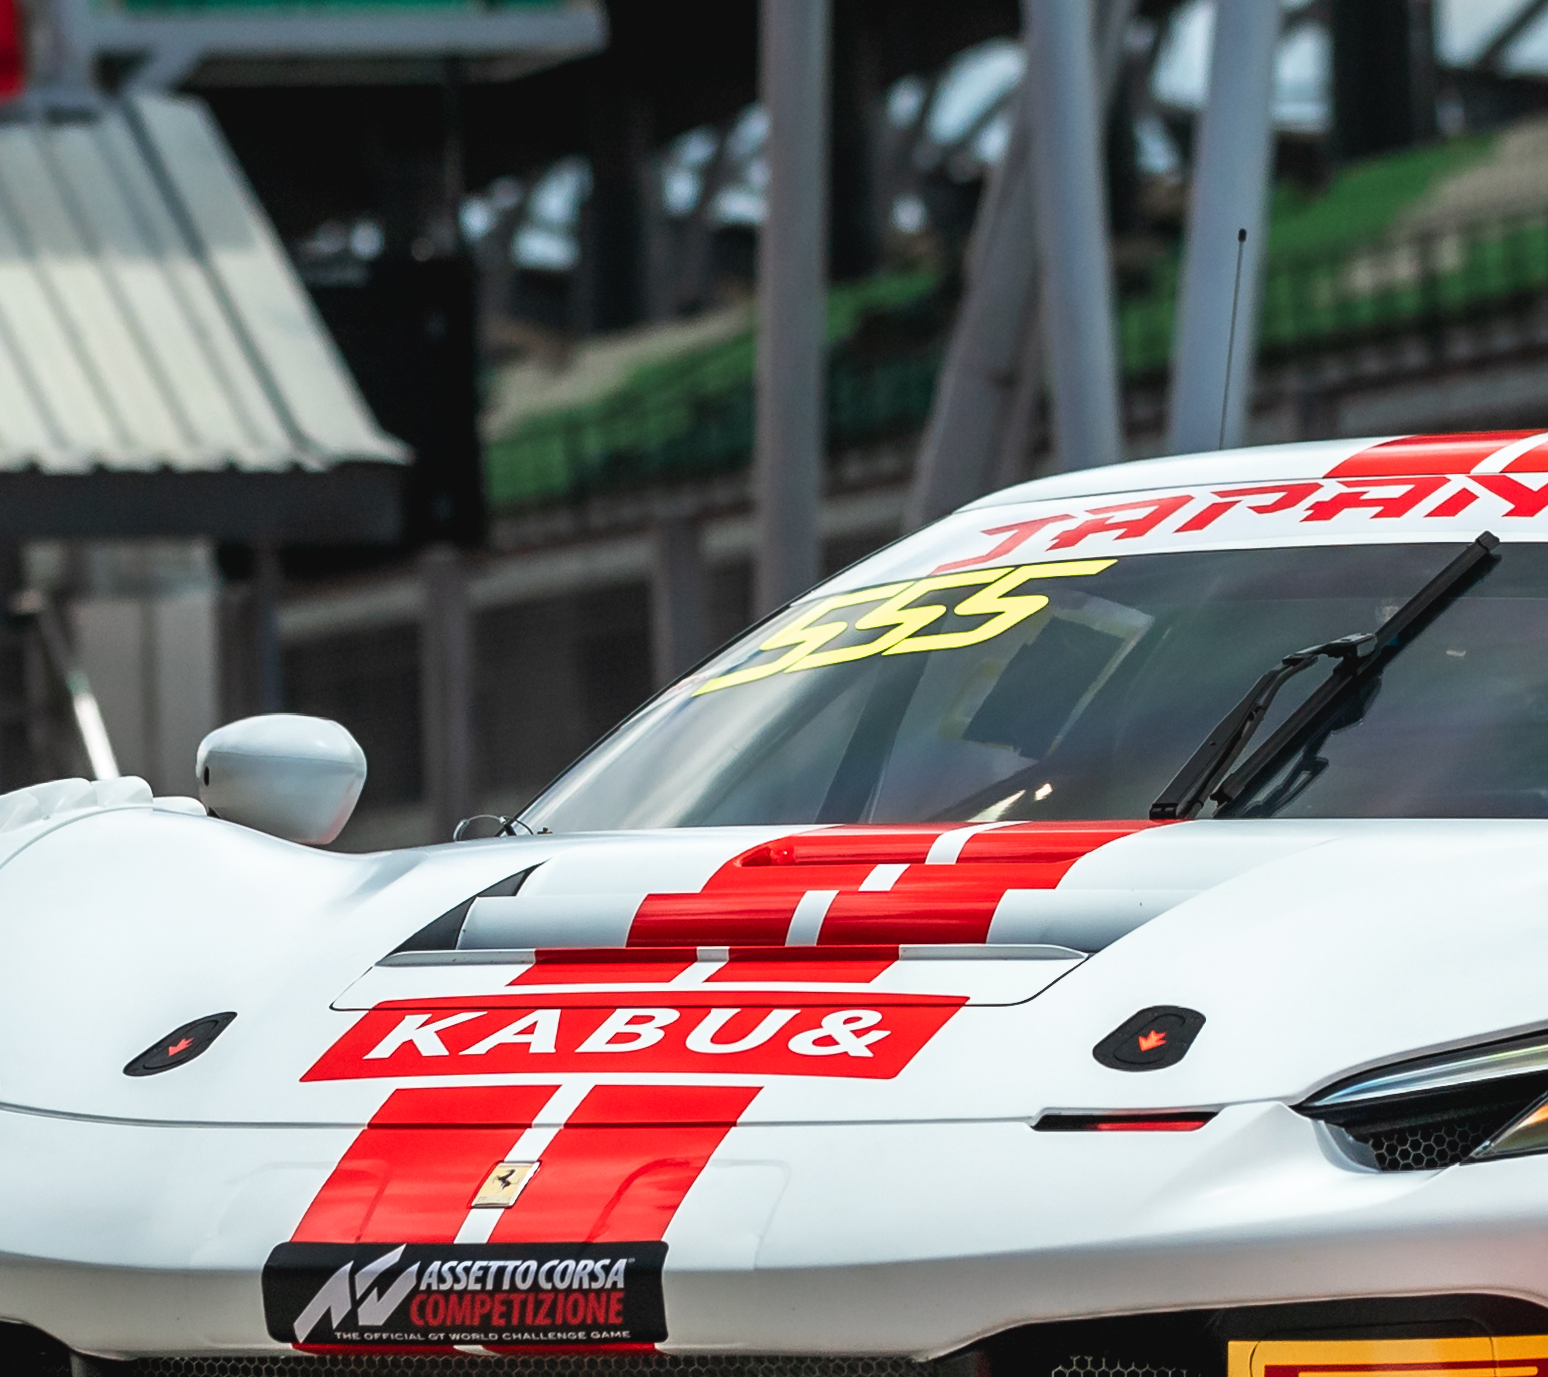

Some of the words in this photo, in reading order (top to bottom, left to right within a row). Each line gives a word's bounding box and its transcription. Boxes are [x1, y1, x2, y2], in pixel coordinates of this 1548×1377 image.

[692, 559, 1118, 697] 555
[363, 1007, 892, 1060] KABU&
[419, 1259, 539, 1291] ASSETTO
[538, 1258, 627, 1289] CORSA
[409, 1291, 626, 1328] COMPETIZIONE
[335, 1331, 360, 1341] THE
[364, 1332, 425, 1342] OFFICIAL
[428, 1332, 446, 1341] GT
[449, 1332, 500, 1341] WORLD
[503, 1330, 587, 1341] CHALLENGE
[590, 1330, 632, 1340] GAME
